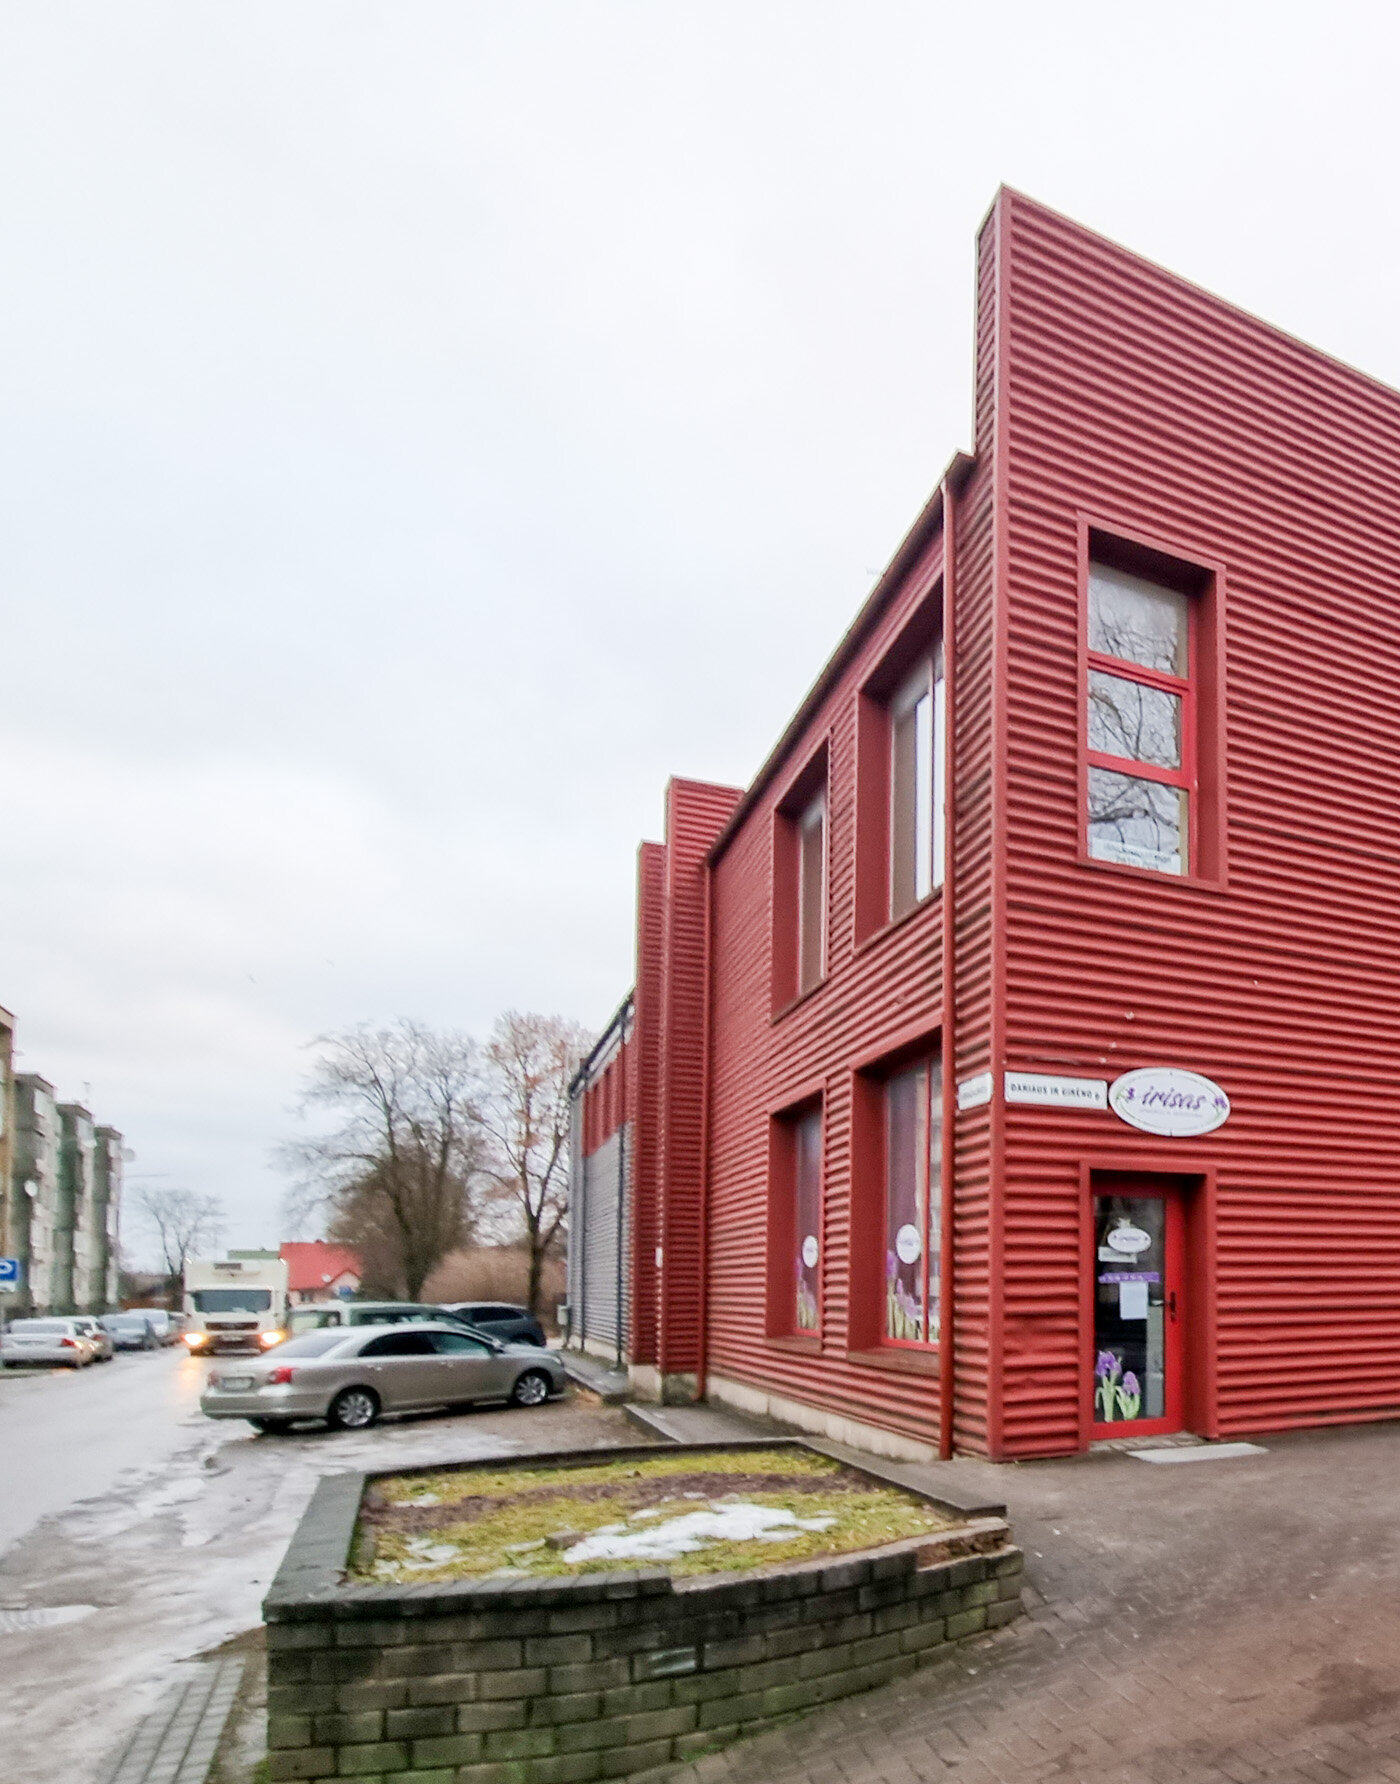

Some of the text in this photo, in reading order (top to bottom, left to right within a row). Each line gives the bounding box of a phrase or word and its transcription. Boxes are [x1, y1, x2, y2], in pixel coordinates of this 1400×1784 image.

[1010, 1083, 1048, 1095] DARIAUS
[1050, 1087, 1060, 1096] IR
[1142, 1085, 1207, 1110] irisas
